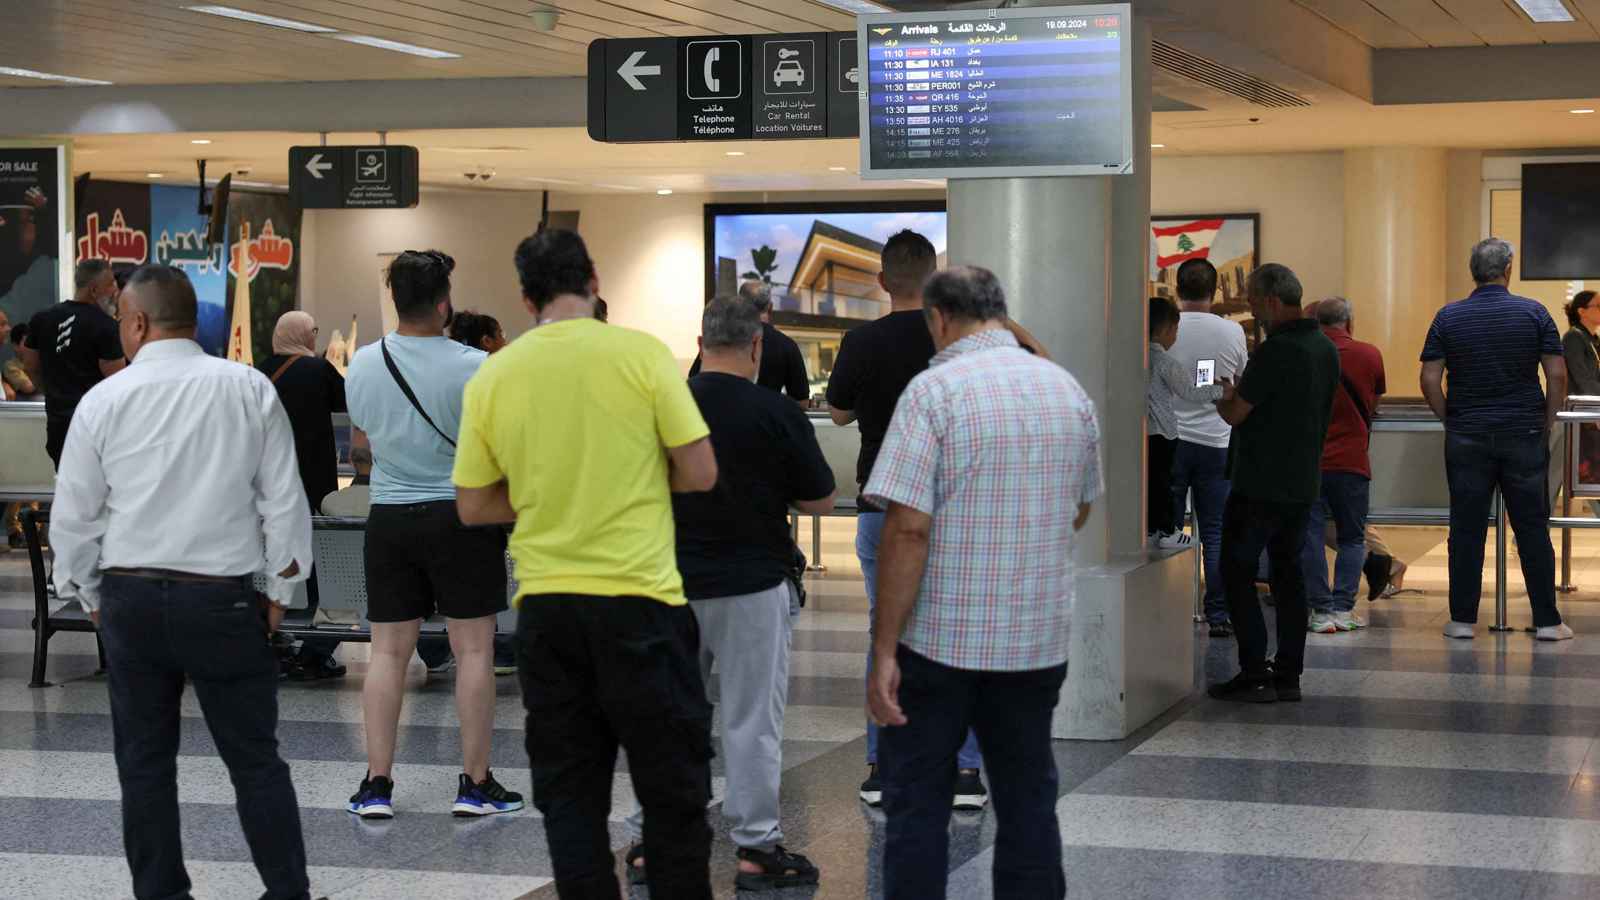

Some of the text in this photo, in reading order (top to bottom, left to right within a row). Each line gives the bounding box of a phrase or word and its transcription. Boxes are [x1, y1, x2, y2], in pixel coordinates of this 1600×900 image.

[976, 21, 1006, 33] الرحلات
[1046, 20, 1087, 29] 19.09.2024
[901, 25, 939, 35] Arrivals
[884, 49, 903, 58] 11:10
[931, 48, 941, 56] RJ
[943, 47, 956, 55] 401
[884, 61, 903, 69] 11:30
[931, 59, 954, 68] IA 131
[884, 73, 904, 81] 11:30
[931, 71, 943, 79] ME
[885, 84, 904, 92] 11:30
[885, 95, 904, 103] 11:35
[931, 93, 943, 101] QR
[702, 104, 724, 112] هاتف
[885, 106, 905, 114] 13:30
[931, 104, 958, 113] EY 535
[693, 115, 735, 124] Telephone
[767, 112, 810, 120] Car Rental
[886, 117, 905, 125] 13:50
[693, 126, 735, 135] Téléphone
[755, 122, 823, 133] Location Voitures
[932, 127, 945, 135] ME
[13, 161, 39, 172] SALE
